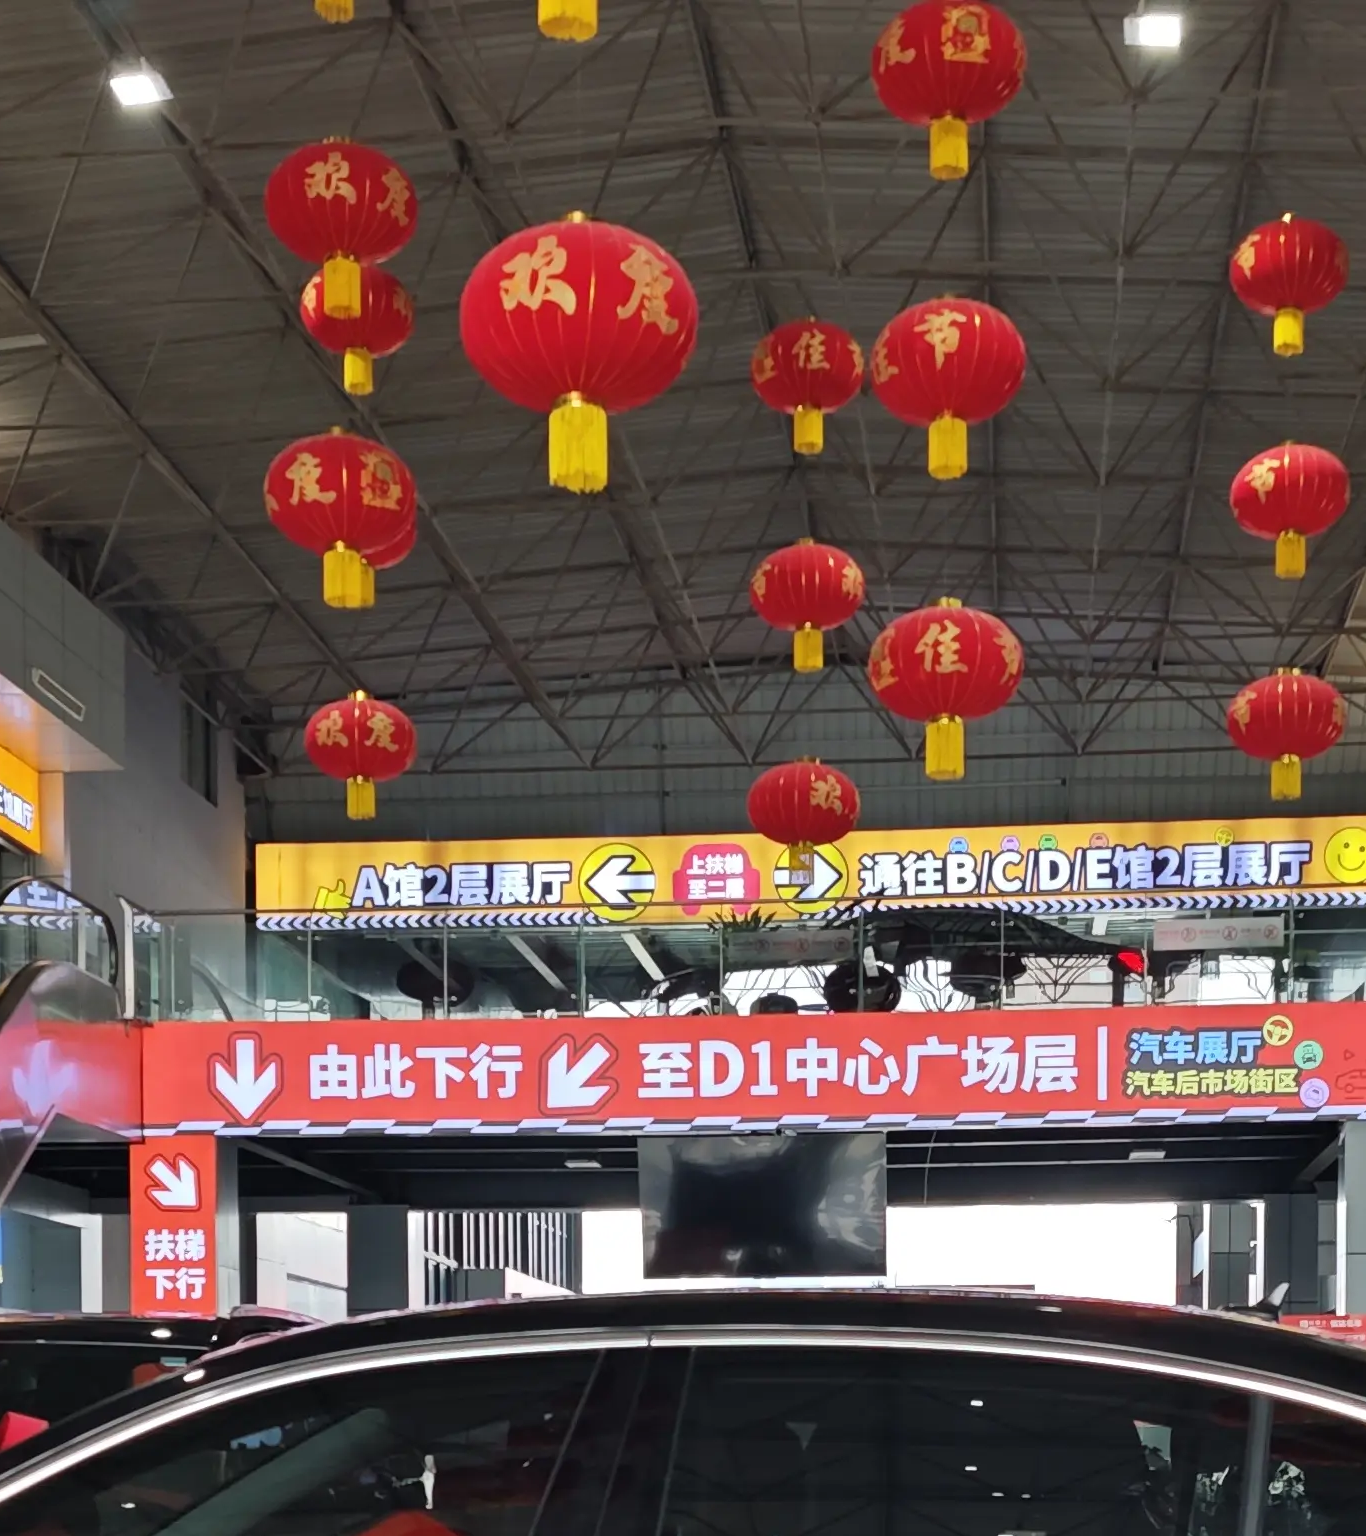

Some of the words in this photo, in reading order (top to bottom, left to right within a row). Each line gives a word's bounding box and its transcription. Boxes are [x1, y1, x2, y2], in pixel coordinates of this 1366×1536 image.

[500, 235, 679, 335] 欢度
[351, 861, 572, 908] A馆2层展厅
[859, 840, 1313, 898] 通往B/C/D/E馆2层展厅
[309, 1042, 523, 1100] 由此下行
[637, 1033, 1079, 1100] 至D1中心广场层
[1130, 1029, 1262, 1067] 汽车展厅
[1125, 1066, 1300, 1098] 汽车后市场街区
[144, 1228, 206, 1263] 扶梯
[144, 1267, 206, 1300] 下行
